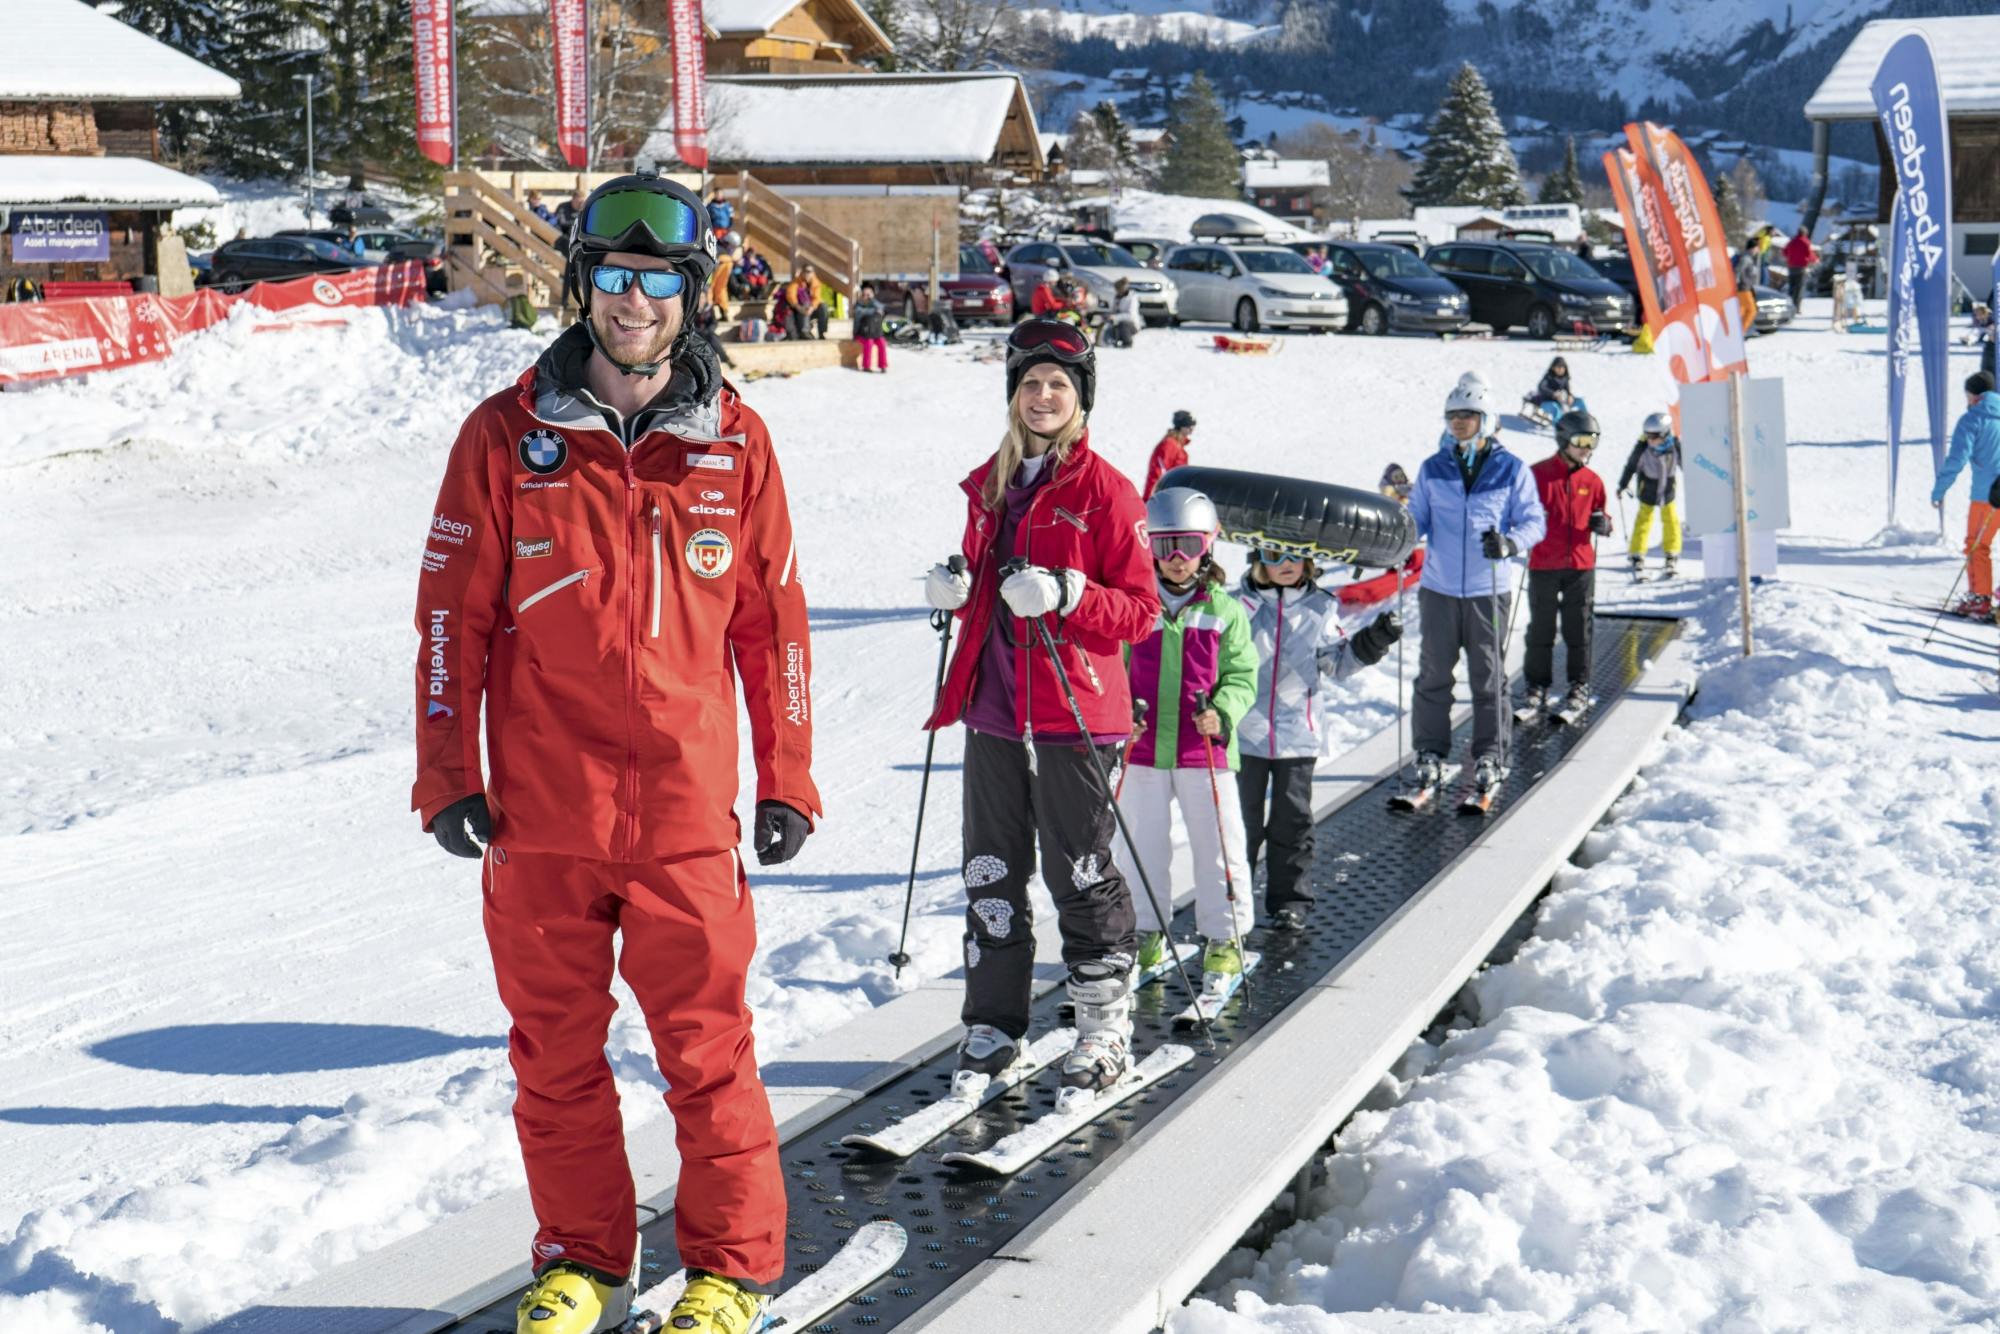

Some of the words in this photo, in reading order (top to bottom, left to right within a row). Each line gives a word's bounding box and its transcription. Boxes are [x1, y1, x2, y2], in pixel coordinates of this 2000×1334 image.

[18, 213, 103, 236] Aberdeen
[523, 429, 563, 444] BMW
[432, 513, 473, 538] rdeen
[516, 541, 550, 557] Ragusa
[430, 609, 450, 696] helvetia
[782, 642, 802, 727] Aberdeen
